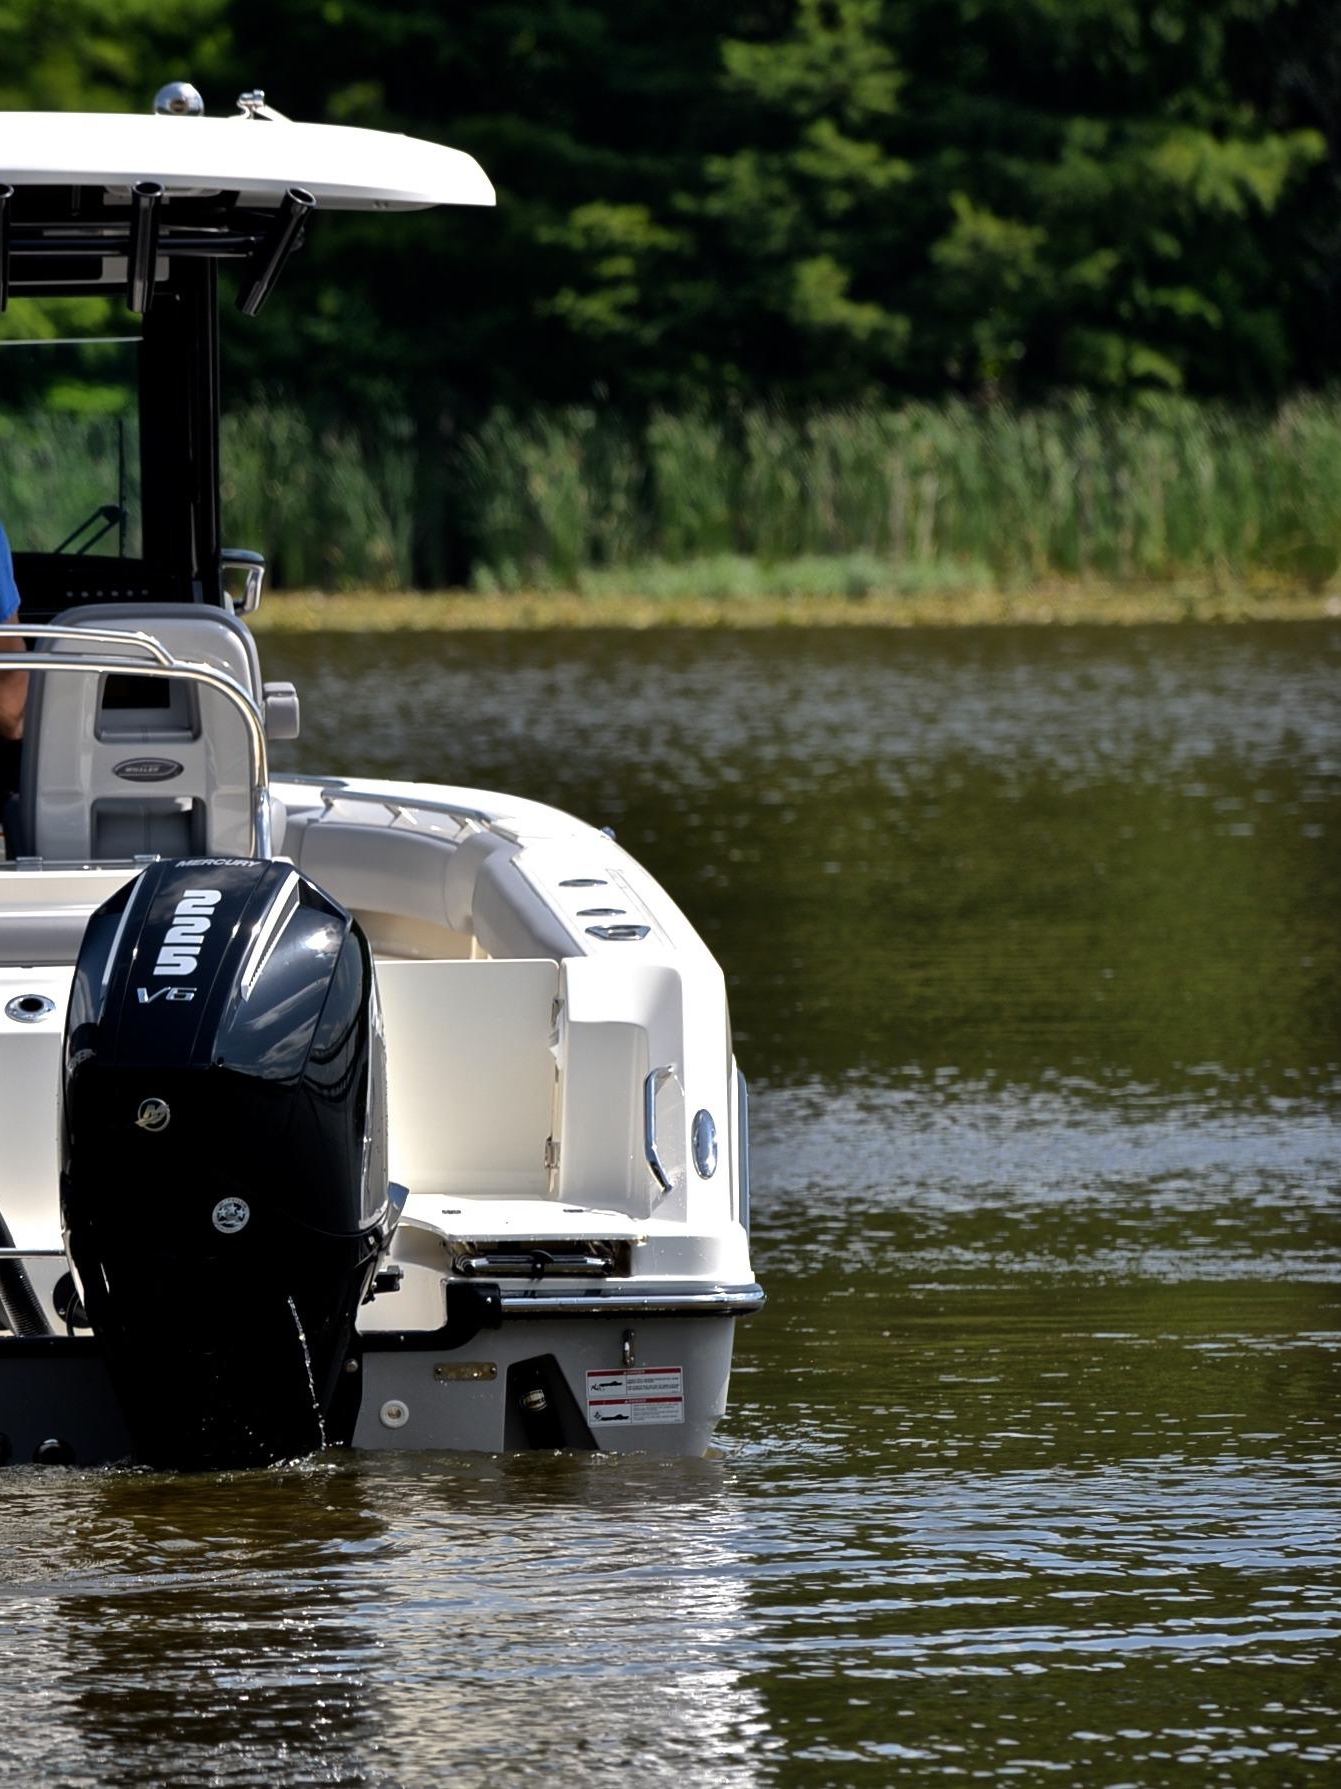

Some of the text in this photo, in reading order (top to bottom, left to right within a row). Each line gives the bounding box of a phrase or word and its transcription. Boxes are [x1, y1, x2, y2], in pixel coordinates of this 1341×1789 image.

[175, 858, 261, 868] MERCURY
[153, 889, 222, 976] 225
[137, 986, 197, 1005] V6
